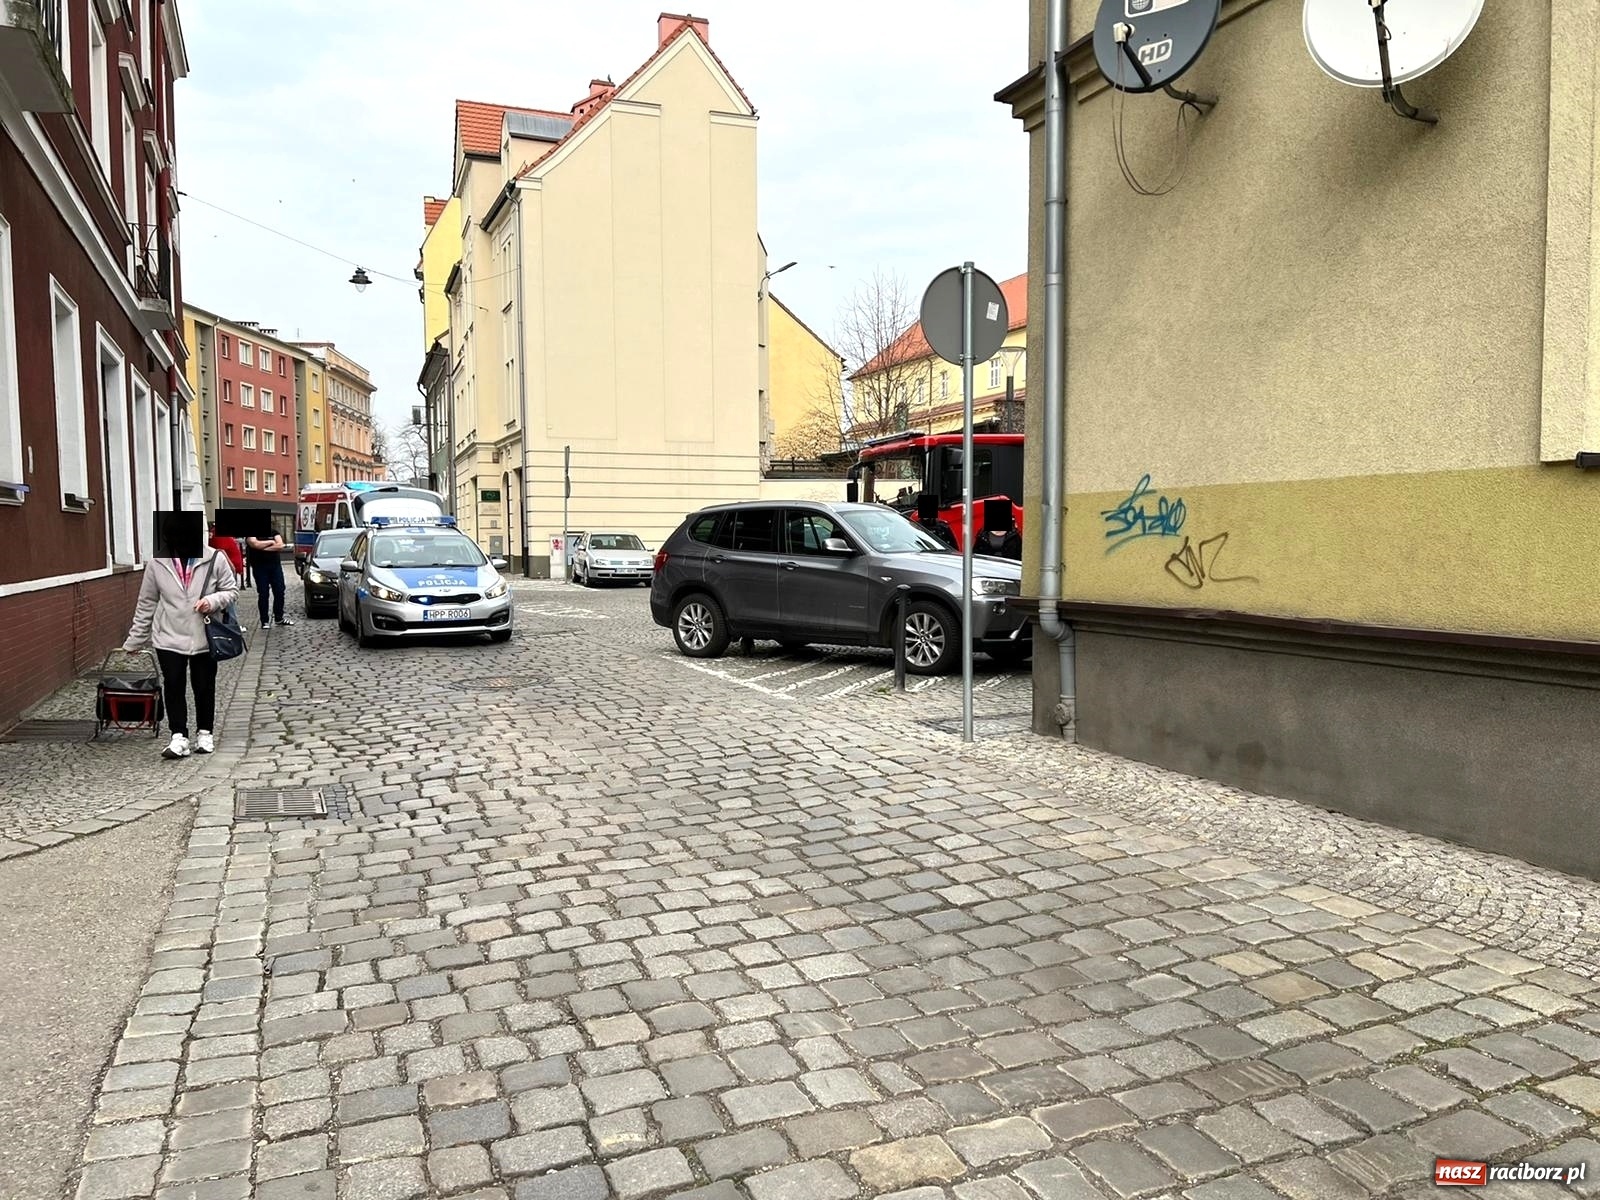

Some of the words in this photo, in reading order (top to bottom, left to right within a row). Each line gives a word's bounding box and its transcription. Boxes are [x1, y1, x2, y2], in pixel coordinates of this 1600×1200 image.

[1140, 42, 1170, 62] HD
[398, 516, 426, 524] POLICJA
[418, 579, 468, 587] POLICJA
[429, 610, 446, 619] HPP
[448, 609, 469, 618] R006
